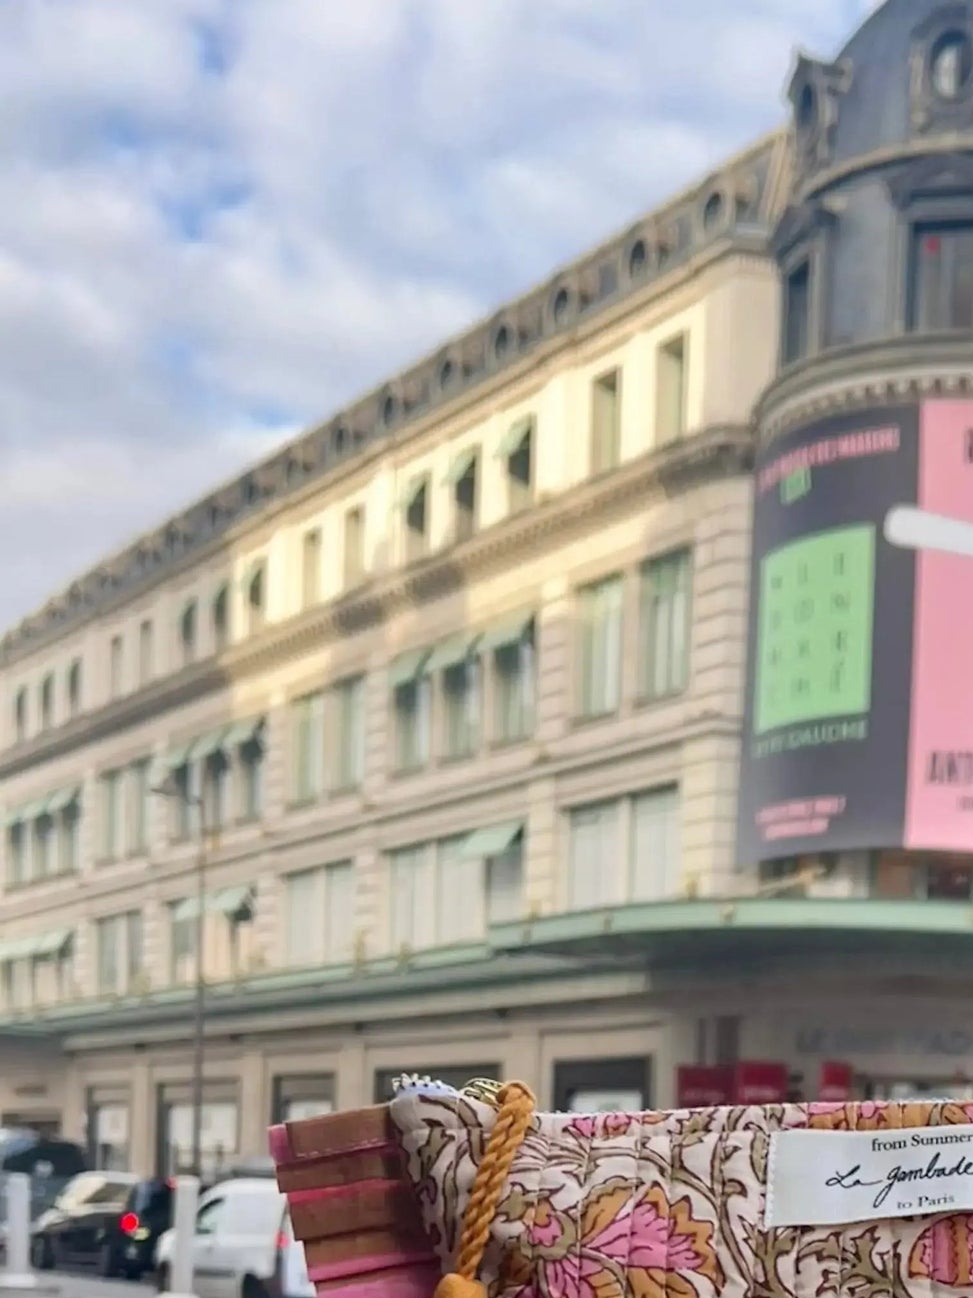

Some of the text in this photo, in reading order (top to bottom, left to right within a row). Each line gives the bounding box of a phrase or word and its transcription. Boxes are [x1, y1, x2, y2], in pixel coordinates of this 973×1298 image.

[871, 1133, 973, 1152] from Summer
[825, 1164, 883, 1189] La
[897, 1195, 956, 1210] to Paris
